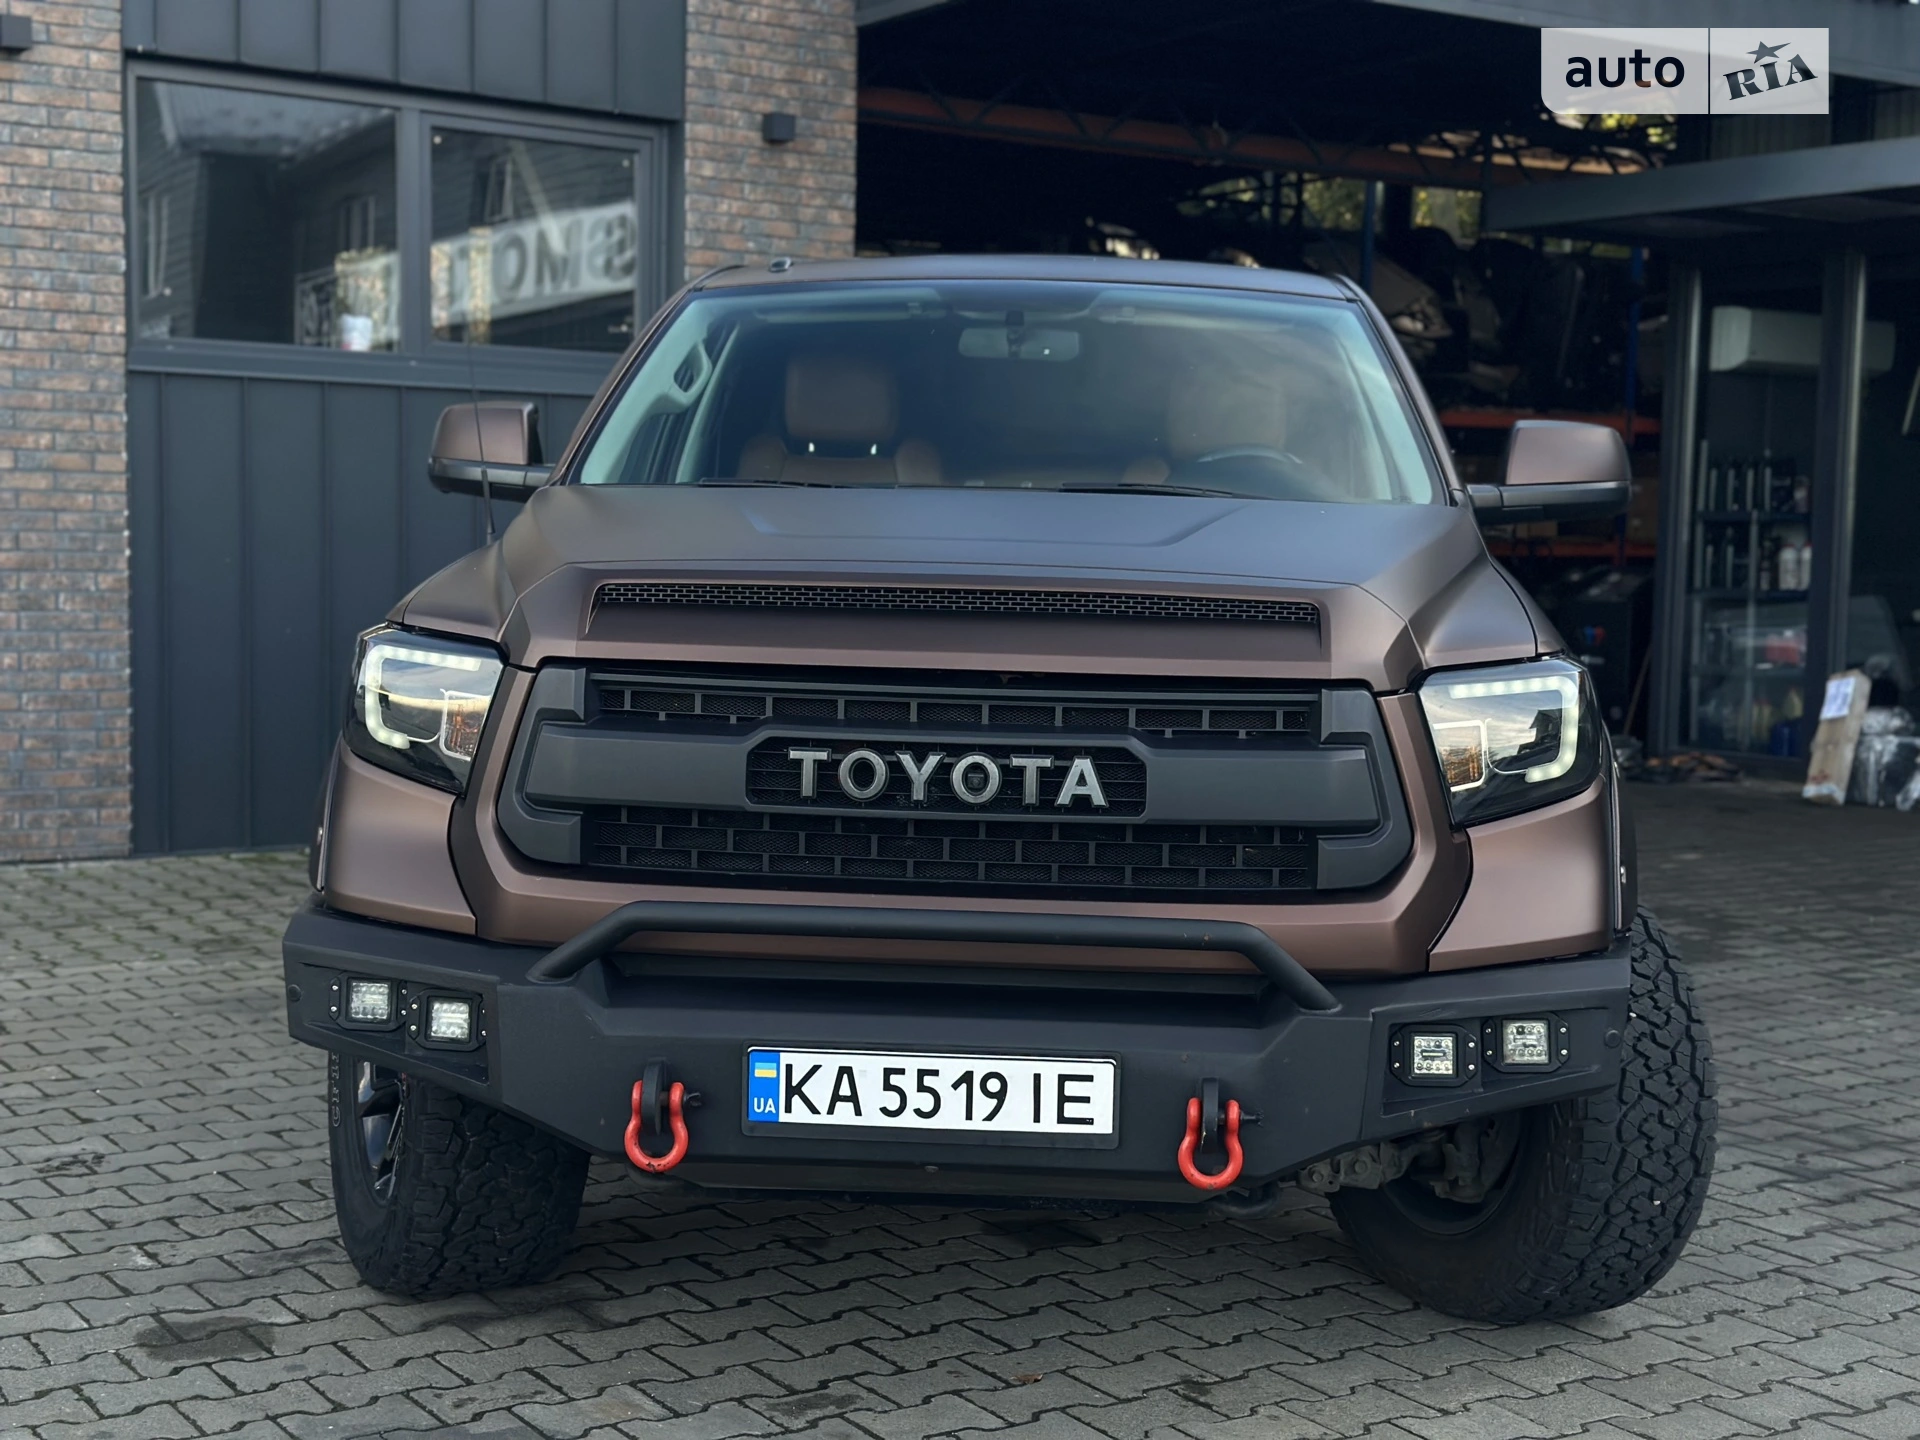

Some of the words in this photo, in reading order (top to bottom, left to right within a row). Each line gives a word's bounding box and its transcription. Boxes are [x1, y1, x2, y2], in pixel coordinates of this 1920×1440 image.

[788, 747, 1108, 808] TOYOTA
[753, 1097, 776, 1114] UA
[783, 1063, 863, 1117] KA
[878, 1067, 1009, 1122] 5519
[1032, 1072, 1095, 1126] IE
